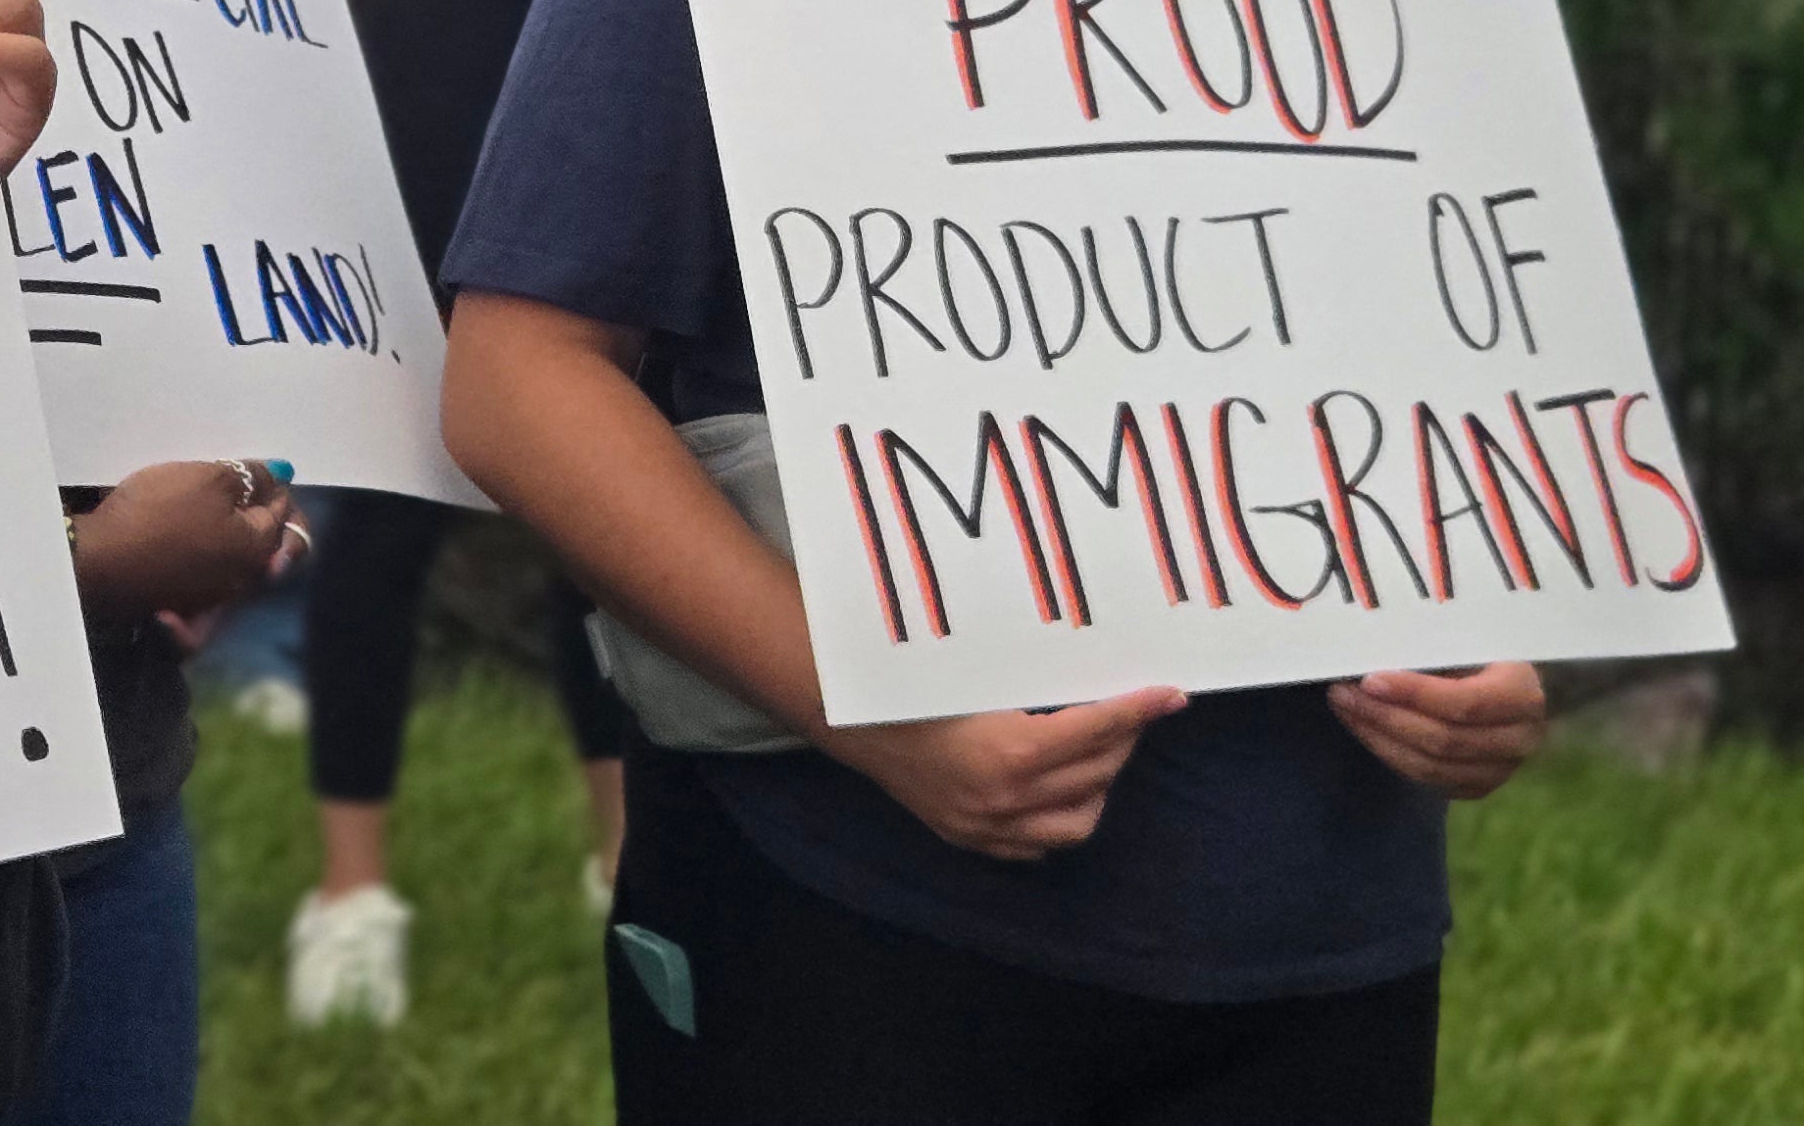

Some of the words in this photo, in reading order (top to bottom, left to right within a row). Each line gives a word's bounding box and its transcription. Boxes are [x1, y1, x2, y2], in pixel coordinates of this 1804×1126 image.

[72, 21, 190, 134] ON
[203, 239, 400, 364] LAND!
[764, 208, 1291, 379] PRODUCT
[1428, 188, 1545, 354] OF
[836, 390, 1703, 644] IMMIGRANTS
